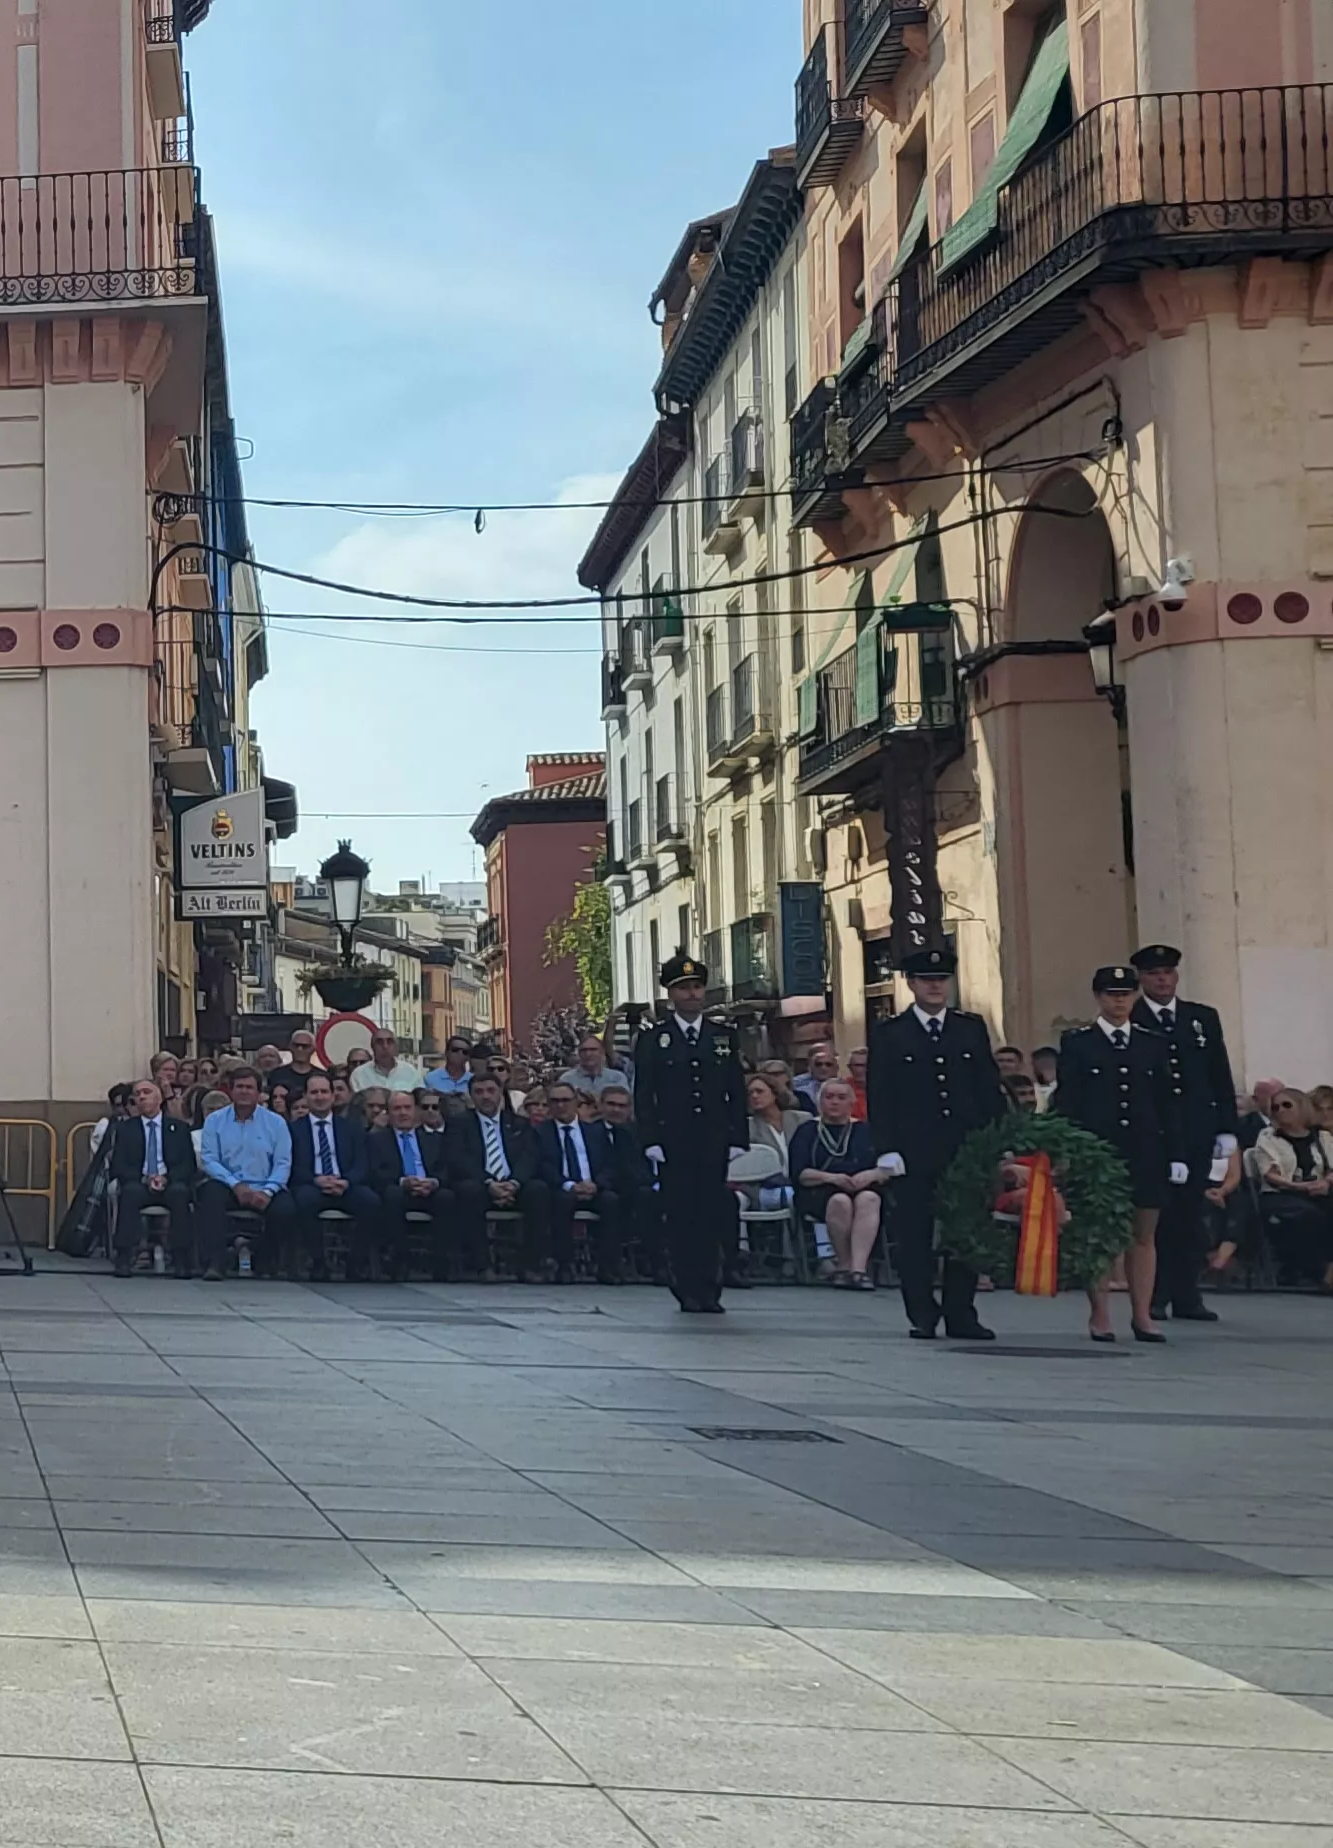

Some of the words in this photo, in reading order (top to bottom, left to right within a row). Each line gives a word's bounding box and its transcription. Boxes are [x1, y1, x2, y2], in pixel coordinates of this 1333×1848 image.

[190, 843, 255, 859] VELTINS
[187, 895, 211, 911] Alt
[214, 895, 261, 911] Berlin
